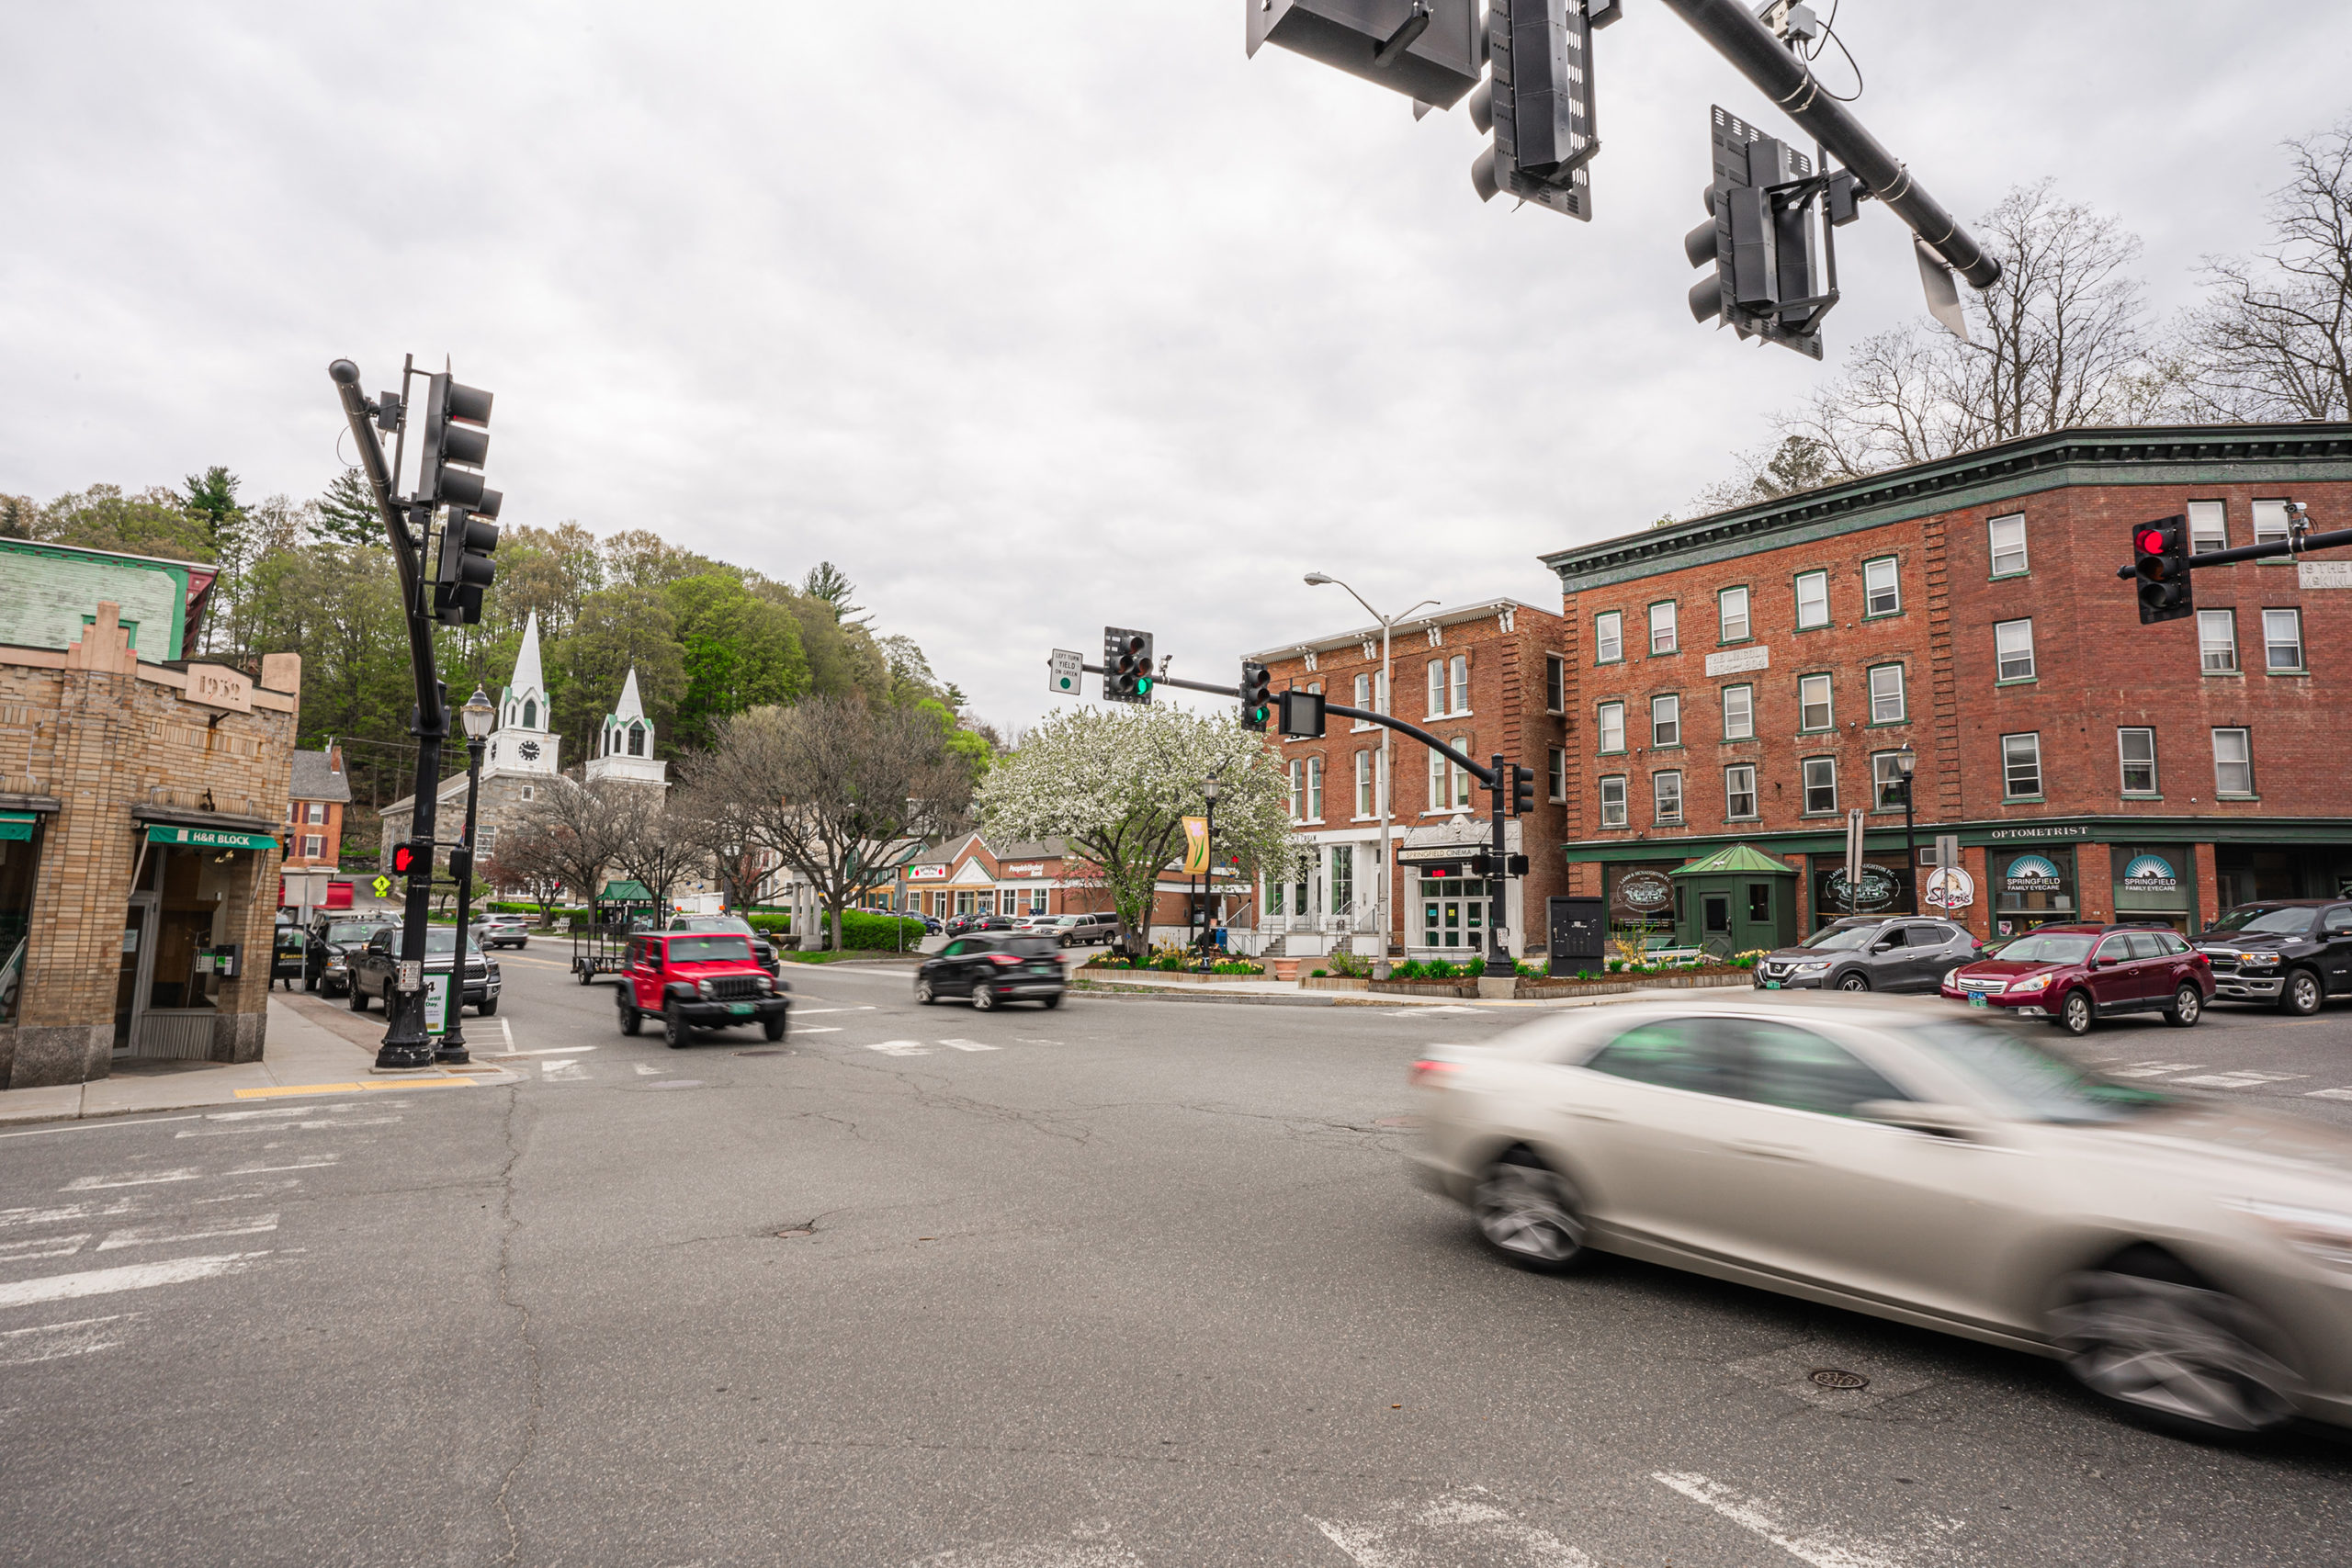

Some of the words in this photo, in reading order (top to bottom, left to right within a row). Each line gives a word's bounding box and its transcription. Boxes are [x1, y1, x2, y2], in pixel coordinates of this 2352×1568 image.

[1058, 660, 1076, 670] YIELD
[199, 675, 240, 701] 1932
[193, 832, 215, 843] H&R
[218, 835, 250, 846] BLOCK
[1992, 826, 2088, 839] OPTOMETRIST
[1406, 849, 1444, 859] SPRINGFIELD
[1446, 849, 1472, 857] CINEMA
[1828, 867, 1843, 880] LAMB
